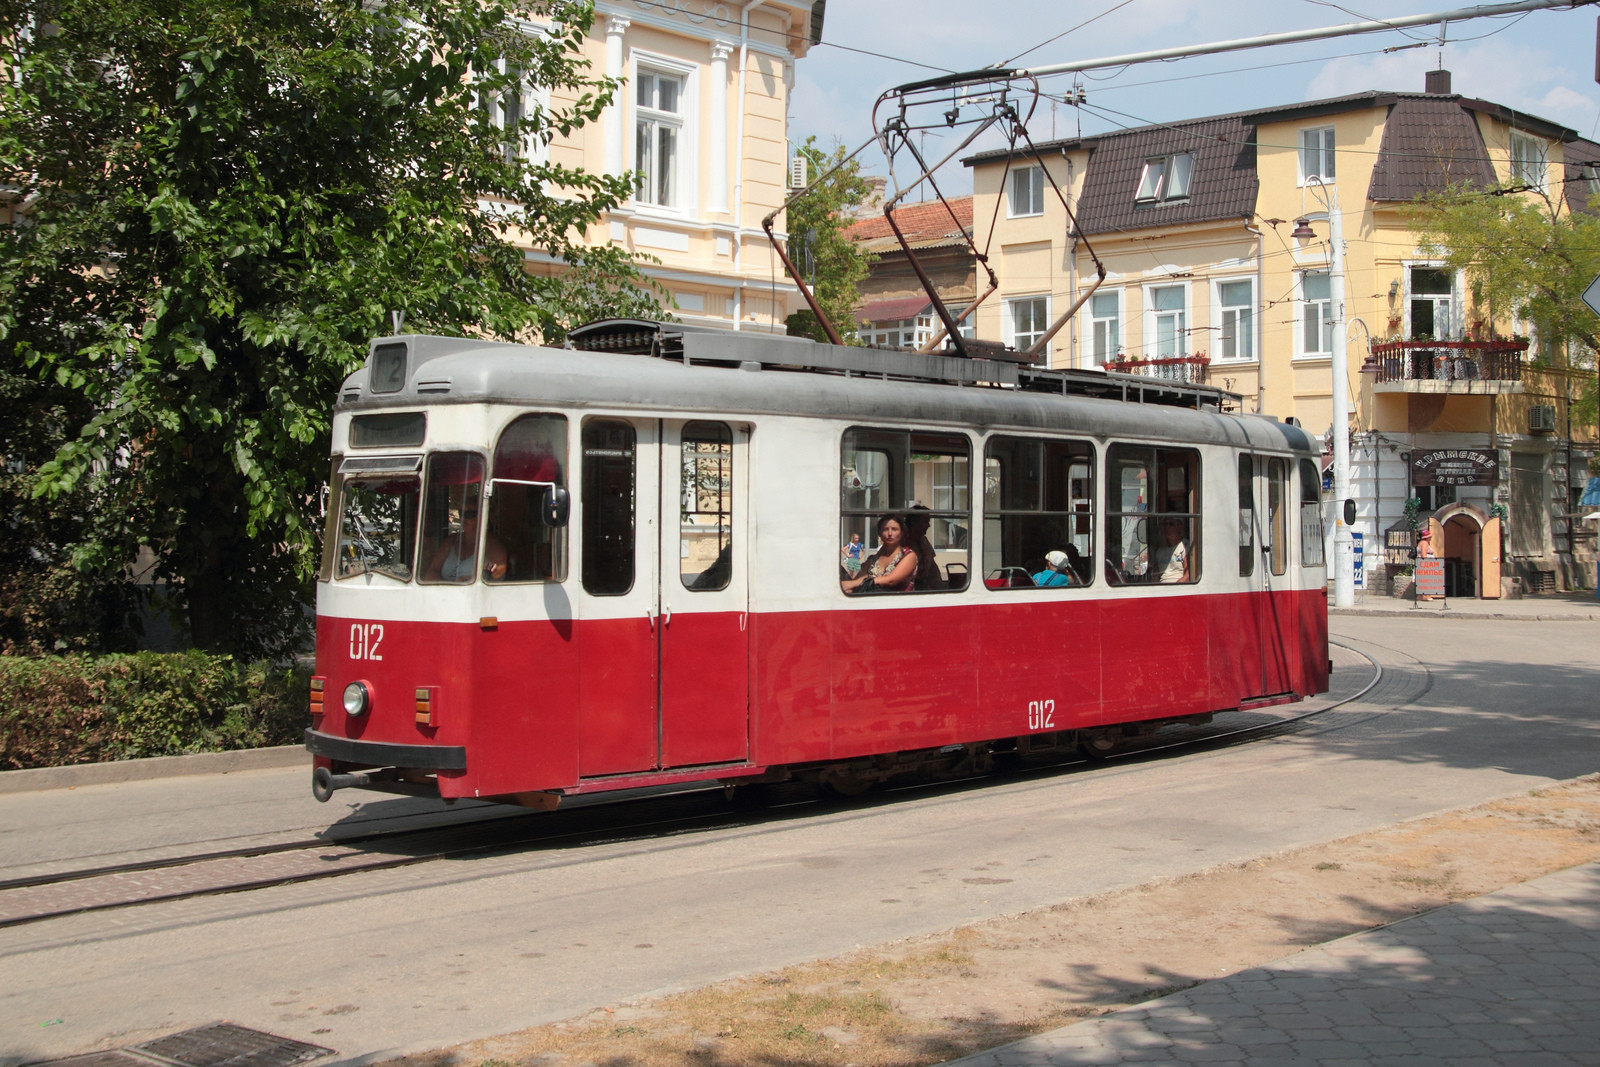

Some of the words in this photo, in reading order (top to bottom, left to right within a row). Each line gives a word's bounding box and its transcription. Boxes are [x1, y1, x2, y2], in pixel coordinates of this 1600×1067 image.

[1415, 450, 1497, 469] КРЫМСКИЕ
[1436, 475, 1477, 485] ВИНА
[1387, 530, 1412, 547] ВИНА
[1416, 569, 1444, 577] ЖИЛЬЕ
[1419, 561, 1441, 569] СДАМ
[349, 623, 385, 661] 012
[1028, 699, 1055, 730] 012
